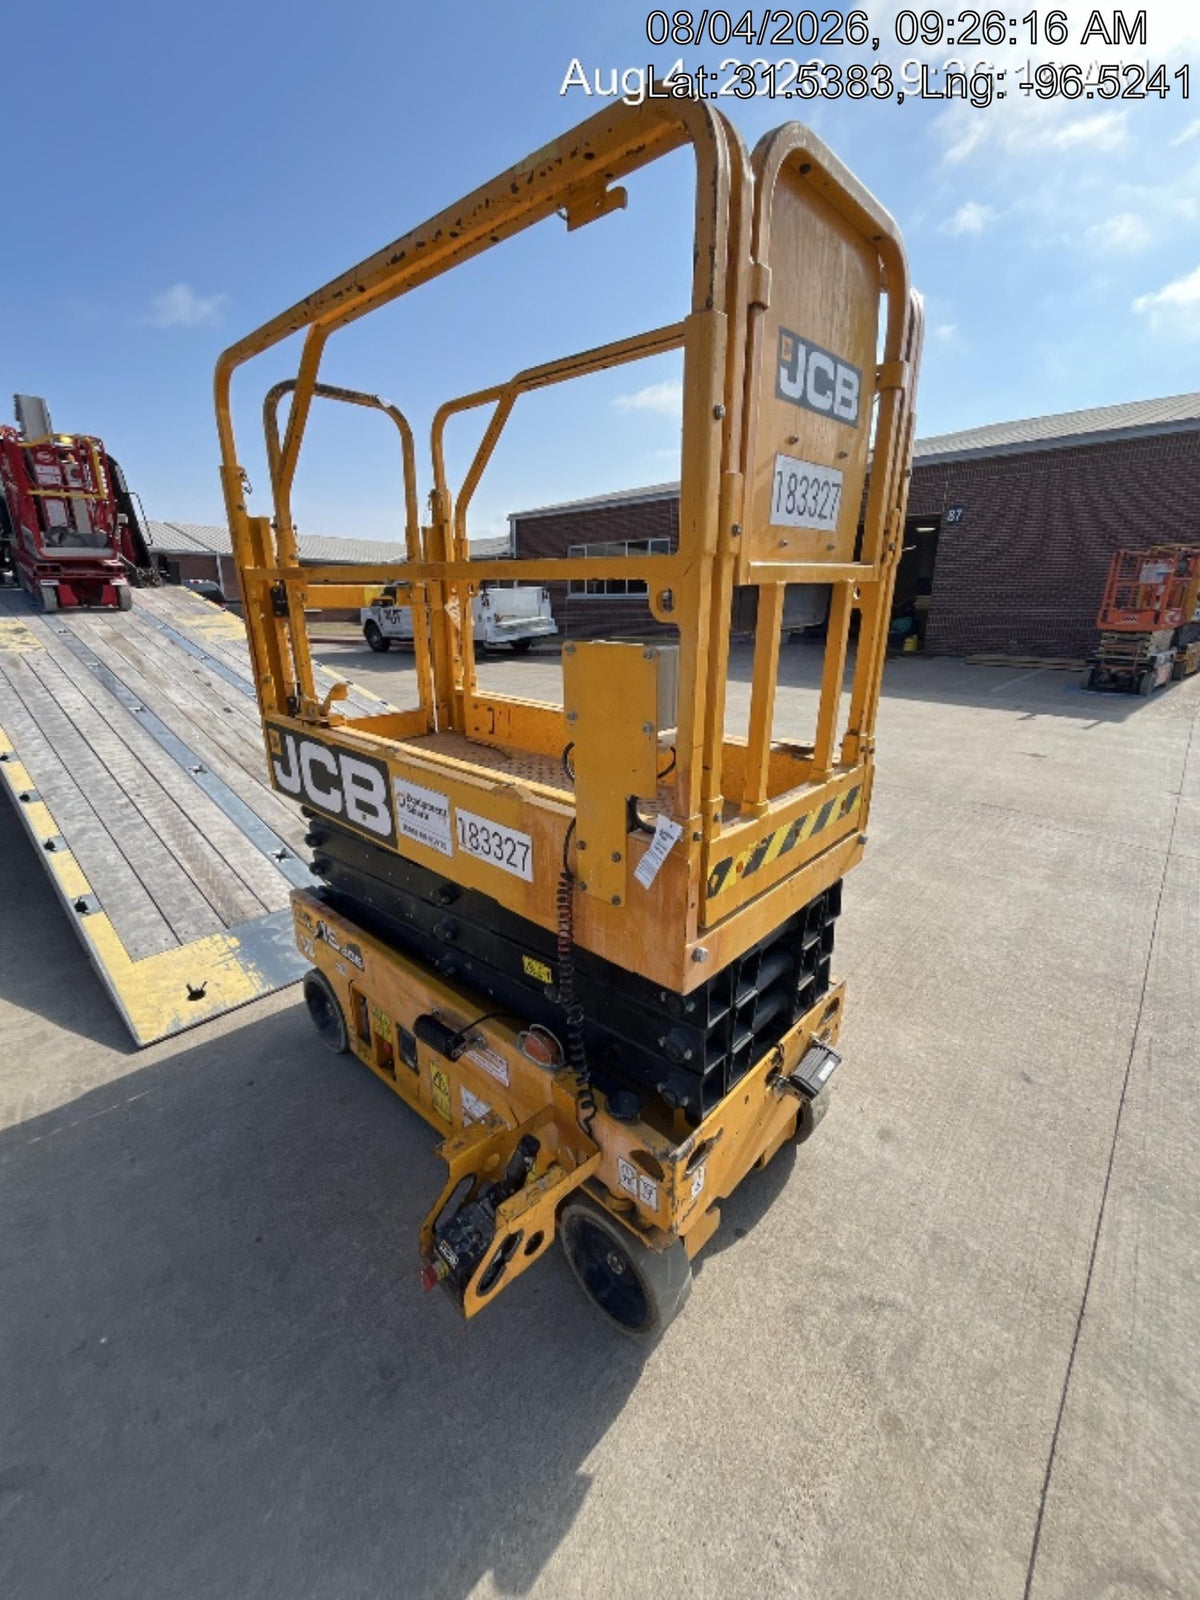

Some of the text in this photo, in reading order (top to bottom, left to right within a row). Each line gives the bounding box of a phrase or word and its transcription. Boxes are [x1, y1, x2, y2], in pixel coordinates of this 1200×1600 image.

[779, 341, 860, 421] JCB
[775, 470, 842, 521] 183327
[273, 735, 392, 837] JCB
[458, 816, 531, 872] 183327
